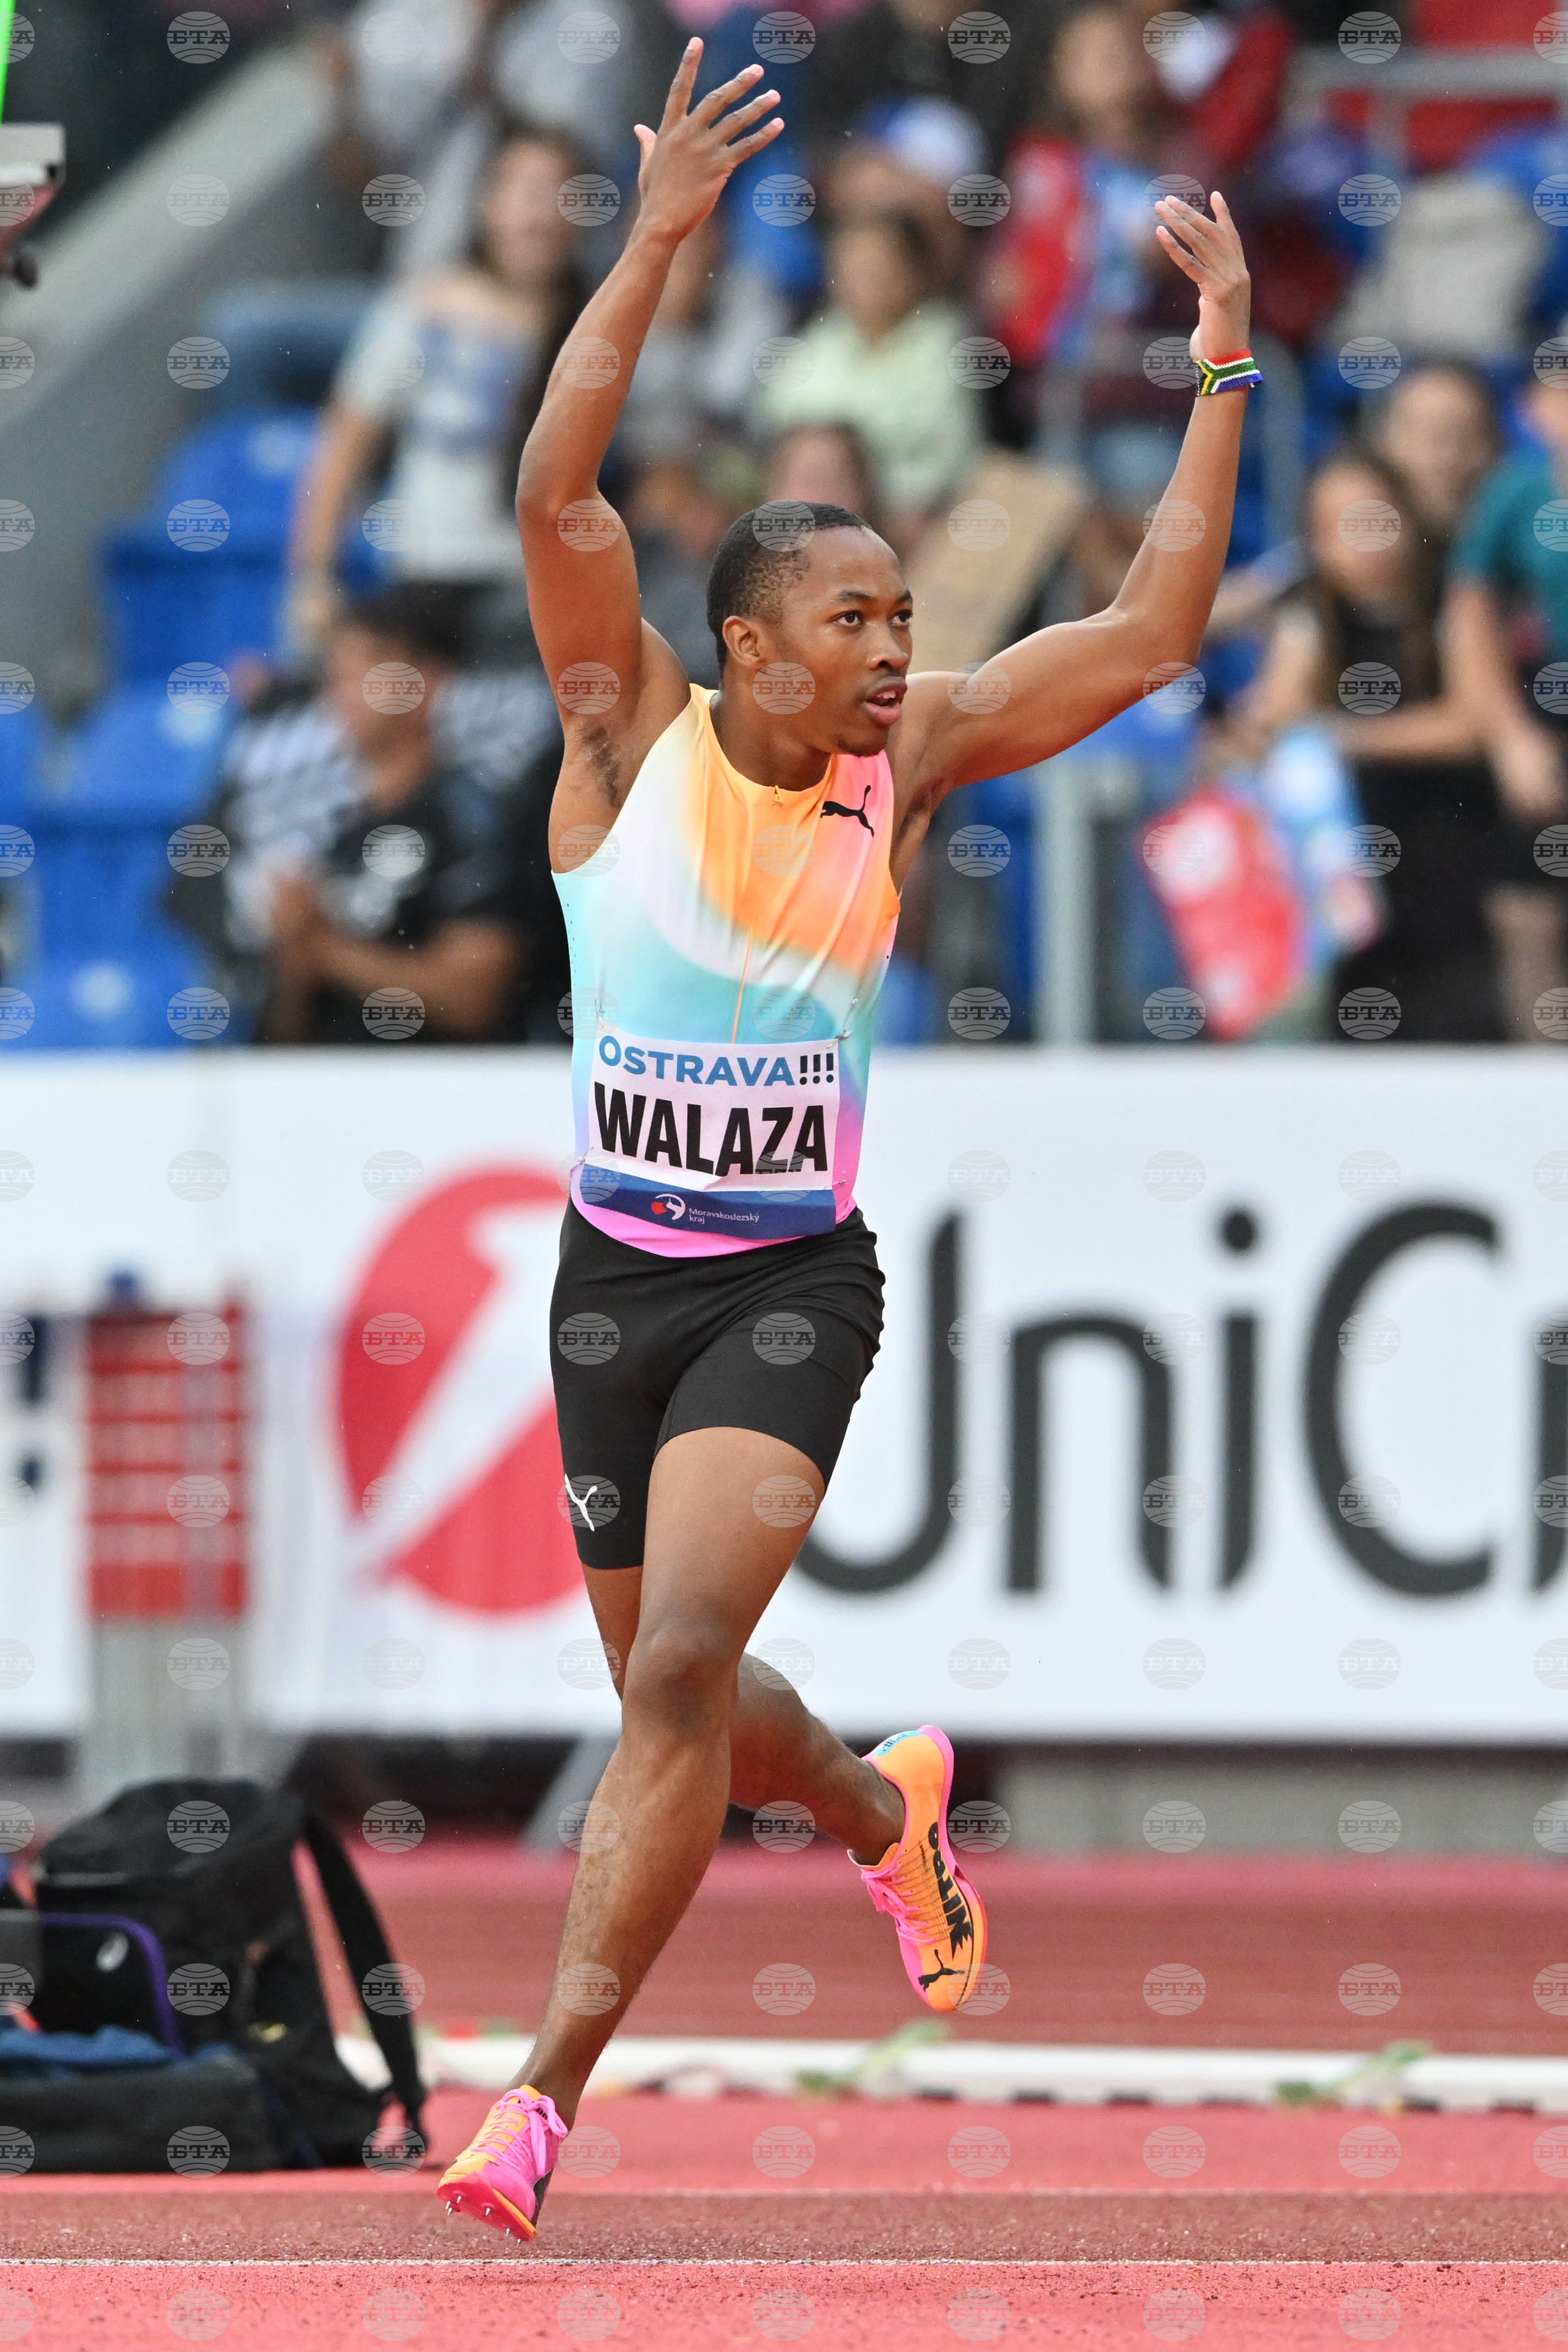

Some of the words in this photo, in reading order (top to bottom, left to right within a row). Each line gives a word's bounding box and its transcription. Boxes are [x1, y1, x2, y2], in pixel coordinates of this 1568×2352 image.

[598, 1034, 834, 1087] OSTRAVA!!!
[594, 1081, 828, 1177] WALAZA
[689, 1207, 760, 1223] Moravskoslezský
[689, 1214, 705, 1224] kraj
